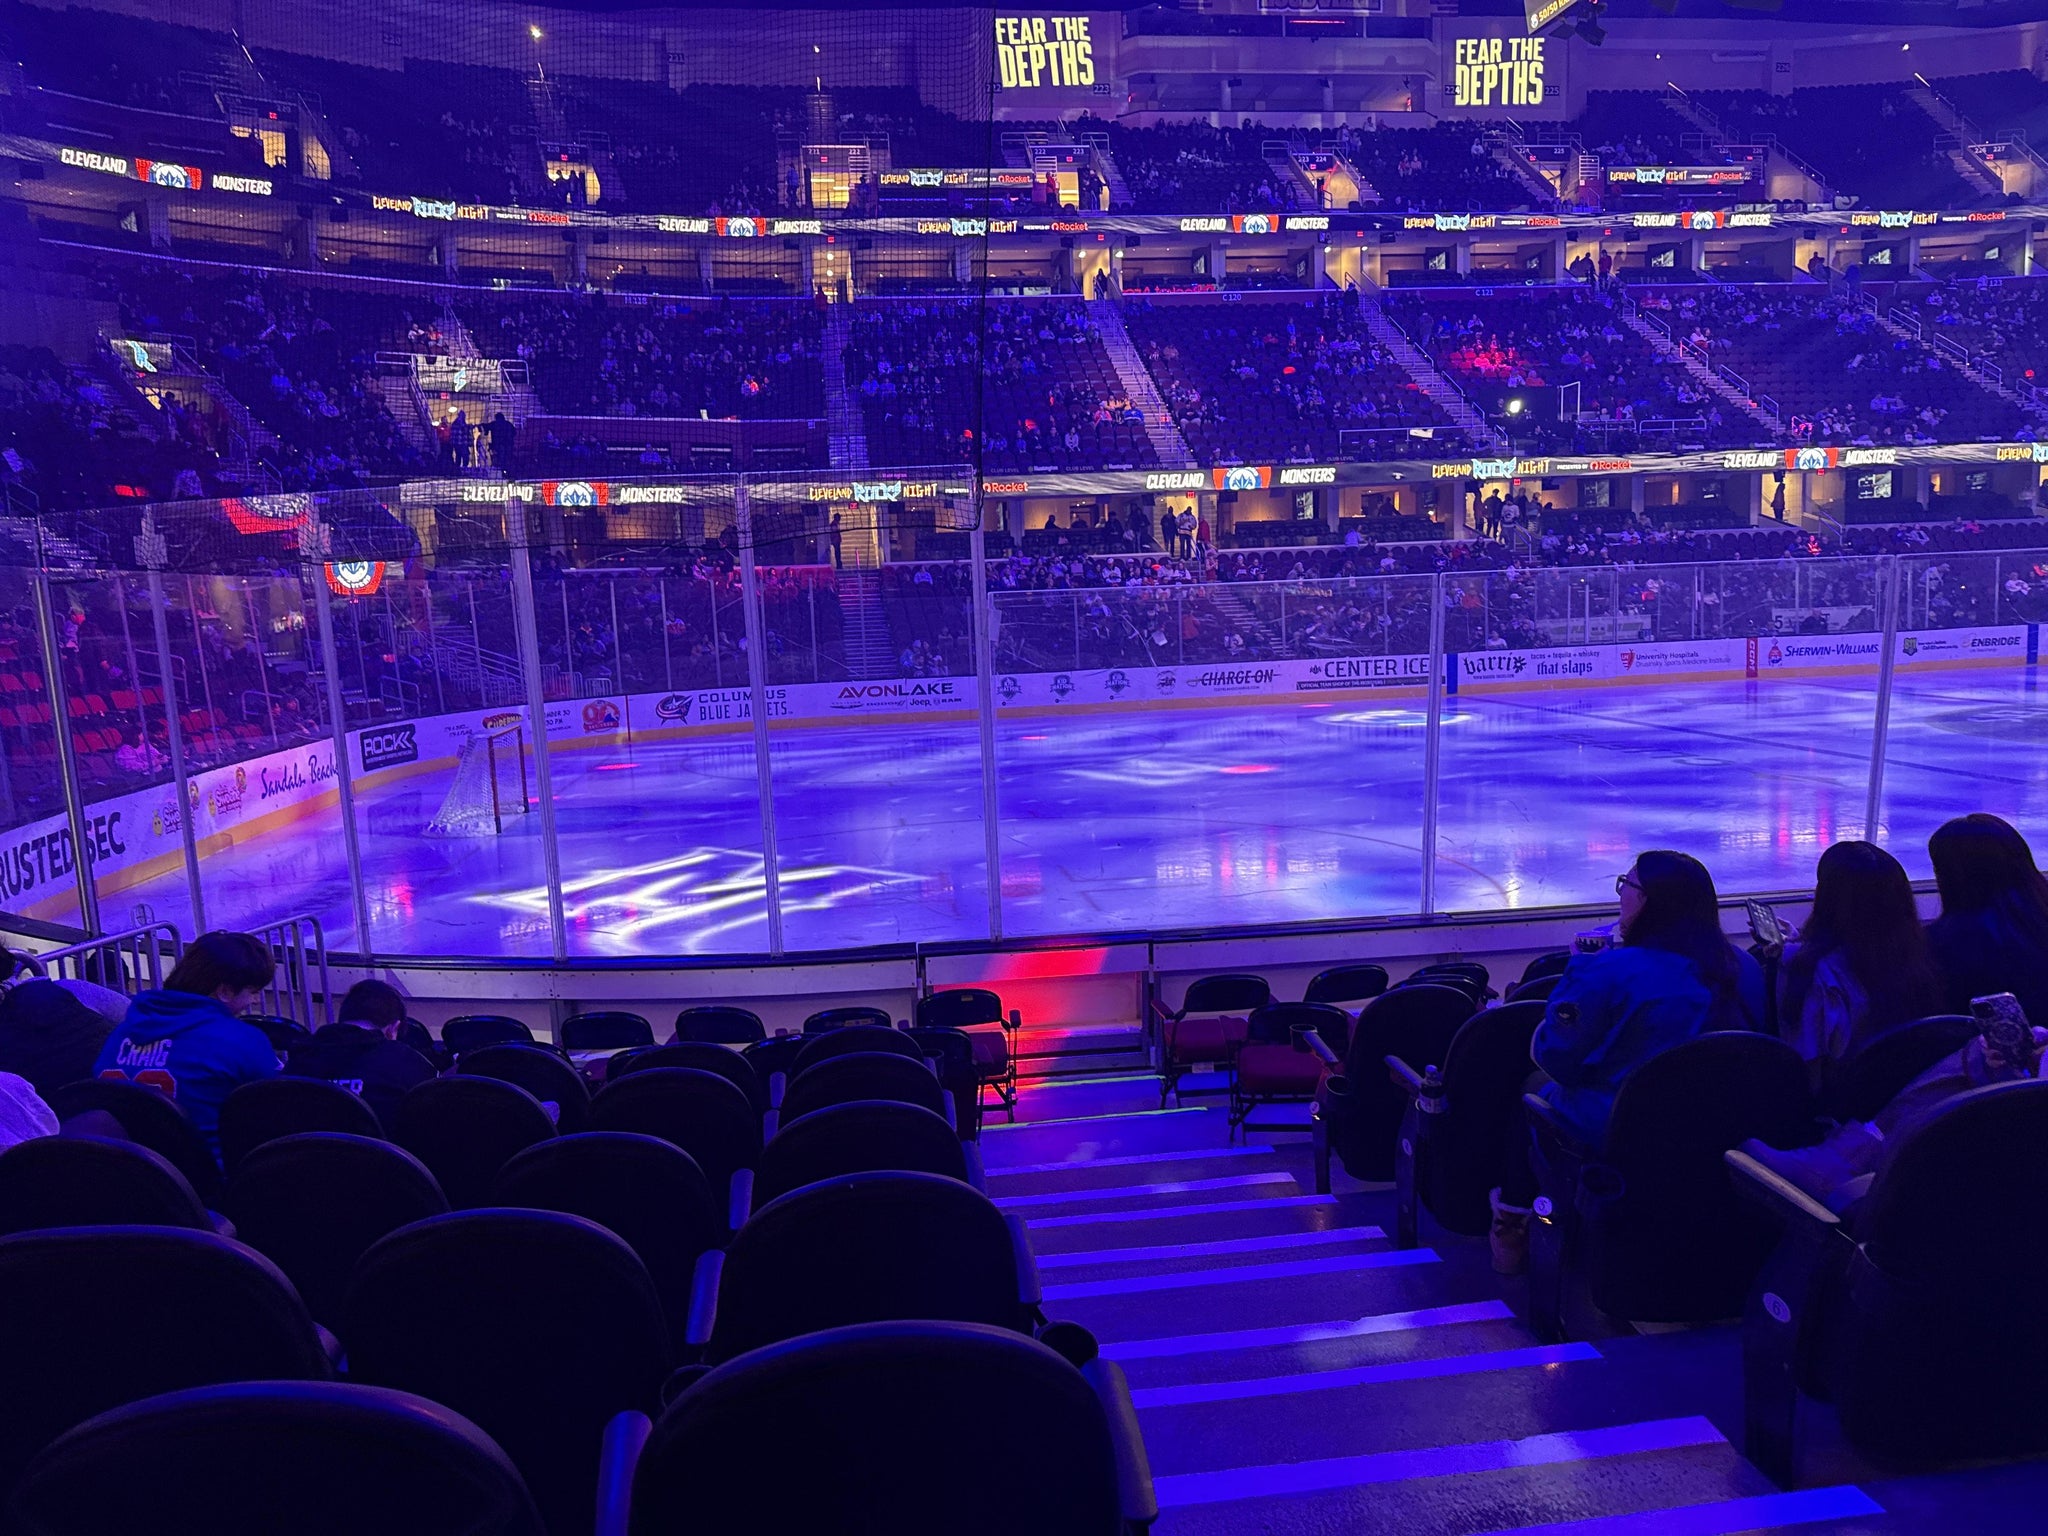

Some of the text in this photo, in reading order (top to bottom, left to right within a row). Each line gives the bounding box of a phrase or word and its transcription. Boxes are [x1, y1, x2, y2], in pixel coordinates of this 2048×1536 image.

[995, 17, 1091, 44] FEAR THE
[1456, 38, 1545, 65] FEAR THE
[998, 41, 1095, 87] DEPTHS
[1094, 84, 1109, 92] 223
[1455, 60, 1543, 106] DEPTHS
[1545, 87, 1559, 95] 225
[61, 148, 272, 196] CLEVELAND MONSTERS
[944, 173, 968, 184] NIGHT
[1005, 174, 1030, 183] Rocket
[1666, 170, 1688, 181] NIGHT
[1719, 172, 1742, 180] Rocket
[372, 196, 412, 212] CLEVELAND
[457, 206, 489, 220] NIGHT
[538, 214, 570, 224] Rocket
[1913, 212, 1938, 224] NIGHT
[1976, 212, 2006, 222] Rocket
[658, 218, 822, 234] CLEVELAND MONSTERS
[990, 220, 1018, 234] NIGHT
[1060, 222, 1088, 232] Rocket
[1180, 217, 1330, 232] CLEVELAND MONSTERS
[1470, 216, 1496, 228] NIGHT
[1534, 218, 1561, 226] Rocket
[1633, 214, 1772, 227] CLEVELAND MONSTERS
[1724, 450, 1896, 468] CLEVELAND MONSTERS
[1996, 448, 2032, 460] CLEVELAND
[1432, 464, 1472, 478] CLEVELAND
[1518, 459, 1550, 474] NIGHT
[1600, 460, 1632, 470] Rocket
[1146, 468, 1336, 490] CLEVELAND MONSTERS
[463, 484, 684, 503] CLEVELAND MONSTERS
[809, 486, 852, 501] CLEVELAND
[903, 484, 938, 498] NIGHT
[992, 482, 1028, 492] Rocket
[1971, 636, 2021, 648] ENBRIDGE
[1578, 650, 1600, 658] whiskey
[1636, 650, 1699, 661] University Hospitals
[1324, 658, 1430, 678] CENTER ICE
[1537, 660, 1593, 676] that slaps
[1201, 668, 1274, 686] CHARGE ON
[698, 690, 786, 704] COLUMUS
[838, 683, 954, 698] AVONLAKE
[910, 698, 930, 706] Jeep
[700, 701, 787, 720] BLUE JAETS
[261, 762, 306, 800] Sandals
[116, 1037, 172, 1066] CRAIG
